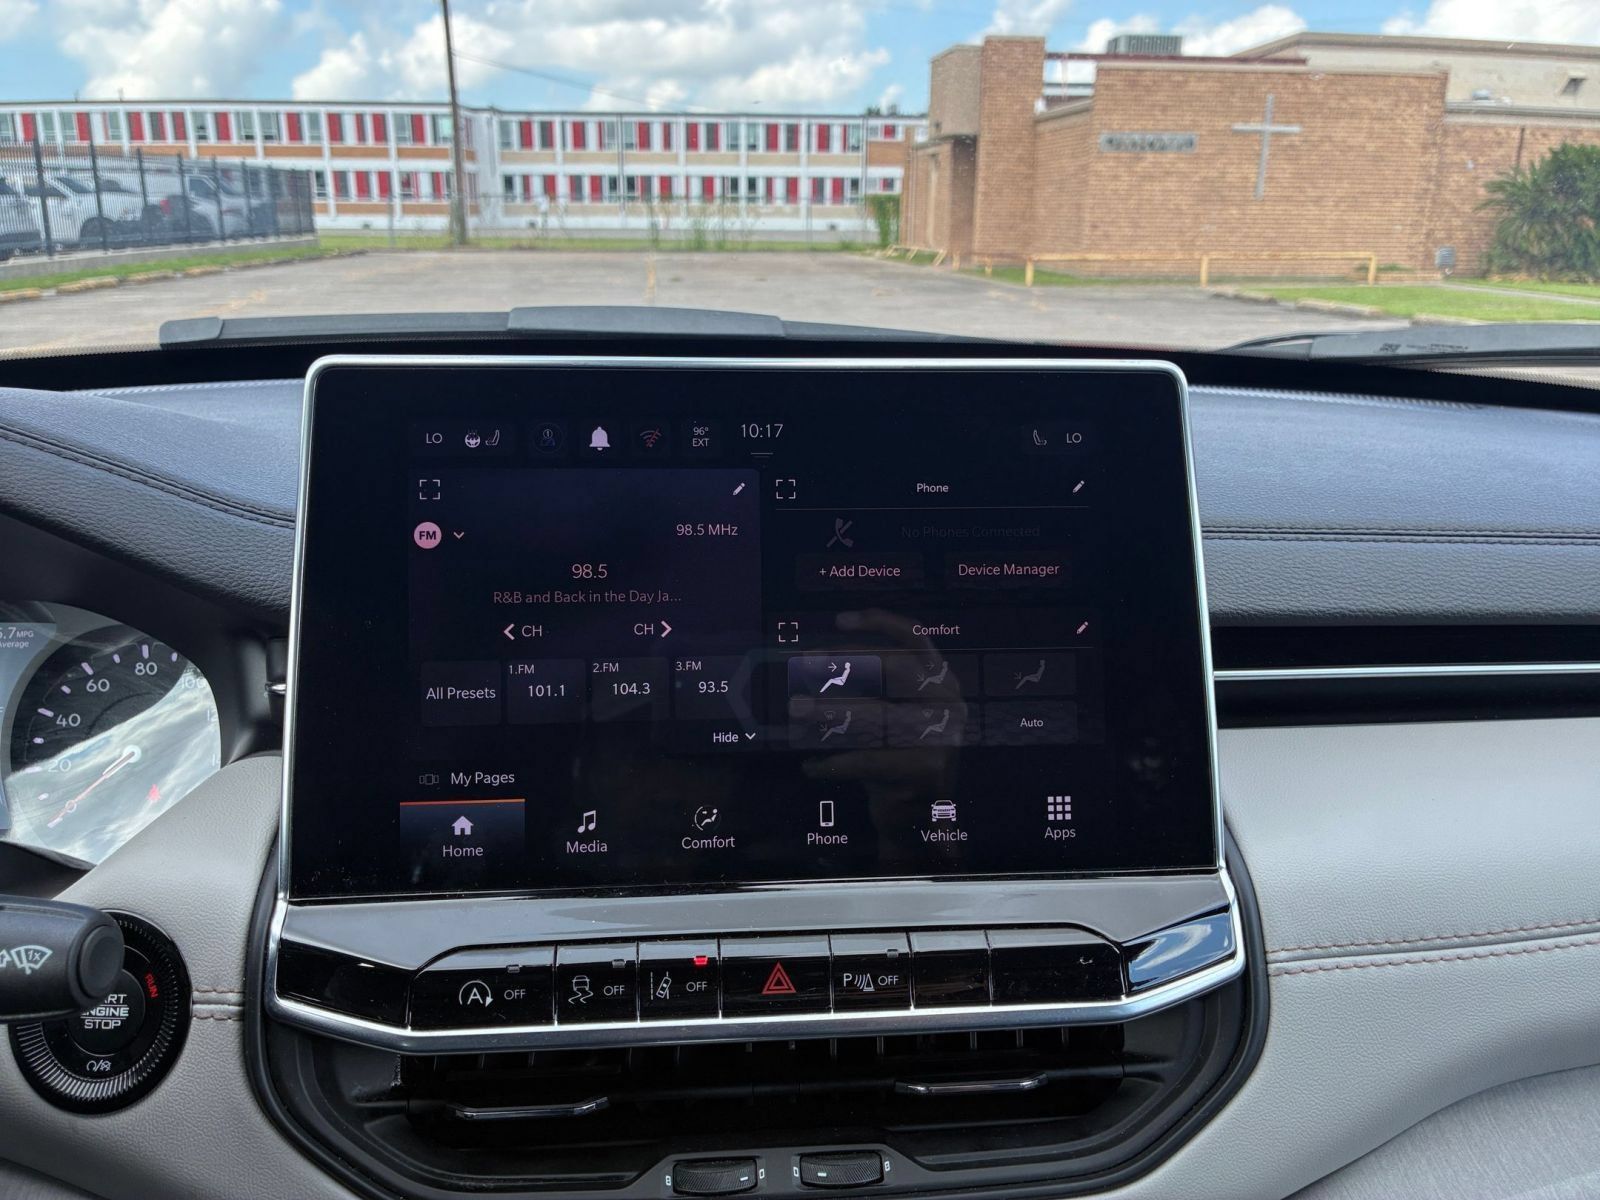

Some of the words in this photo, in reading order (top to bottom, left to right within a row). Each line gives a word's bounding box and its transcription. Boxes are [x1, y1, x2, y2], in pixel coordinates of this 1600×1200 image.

[426, 432, 443, 444] LO
[741, 423, 784, 439] 10:17
[1066, 432, 1082, 444] LO
[692, 437, 710, 447] EXT
[916, 482, 949, 494] Phone
[418, 529, 437, 542] FM
[676, 523, 705, 536] 98.5
[708, 523, 739, 537] MHz
[900, 526, 920, 539] No
[922, 526, 969, 539] Phones
[971, 525, 1041, 538] Connected
[571, 563, 608, 580] 98.5
[829, 565, 855, 578] Add
[858, 565, 901, 577] Device
[958, 563, 1001, 576] Device
[1004, 563, 1060, 580] Manager
[493, 591, 522, 604] R&B
[525, 591, 551, 604] and
[553, 590, 586, 603] Back
[588, 590, 601, 603] in
[604, 590, 627, 603] the
[629, 590, 655, 606] Day
[16, 630, 34, 639] MPG
[521, 624, 543, 638] CH
[633, 622, 655, 636] CH
[912, 623, 961, 636] Comfort
[134, 662, 158, 676] 80
[508, 664, 535, 675] 1.FM
[592, 662, 620, 674] 2.FM
[675, 660, 703, 672] 3.FM
[86, 678, 111, 693] 60
[426, 687, 444, 700] All
[447, 685, 497, 700] Presets
[527, 683, 566, 698] 101.1
[611, 681, 651, 697] 104.3
[698, 680, 729, 694] 93.5
[56, 713, 81, 728] 40
[1020, 716, 1045, 729] Auto
[712, 731, 740, 744] Hide
[47, 758, 72, 773] 20
[450, 770, 473, 787] My
[474, 770, 516, 788] Pages
[806, 831, 849, 846] Phone
[920, 827, 969, 843] Vehicle
[1044, 825, 1077, 841] Apps
[566, 839, 609, 854] Media
[681, 835, 737, 850] Comfort
[442, 843, 485, 858] Home
[686, 980, 708, 993] OFF
[878, 974, 899, 986] OFF
[503, 988, 526, 1000] OFF
[603, 984, 625, 996] OFF
[84, 1018, 121, 1030] STOP
